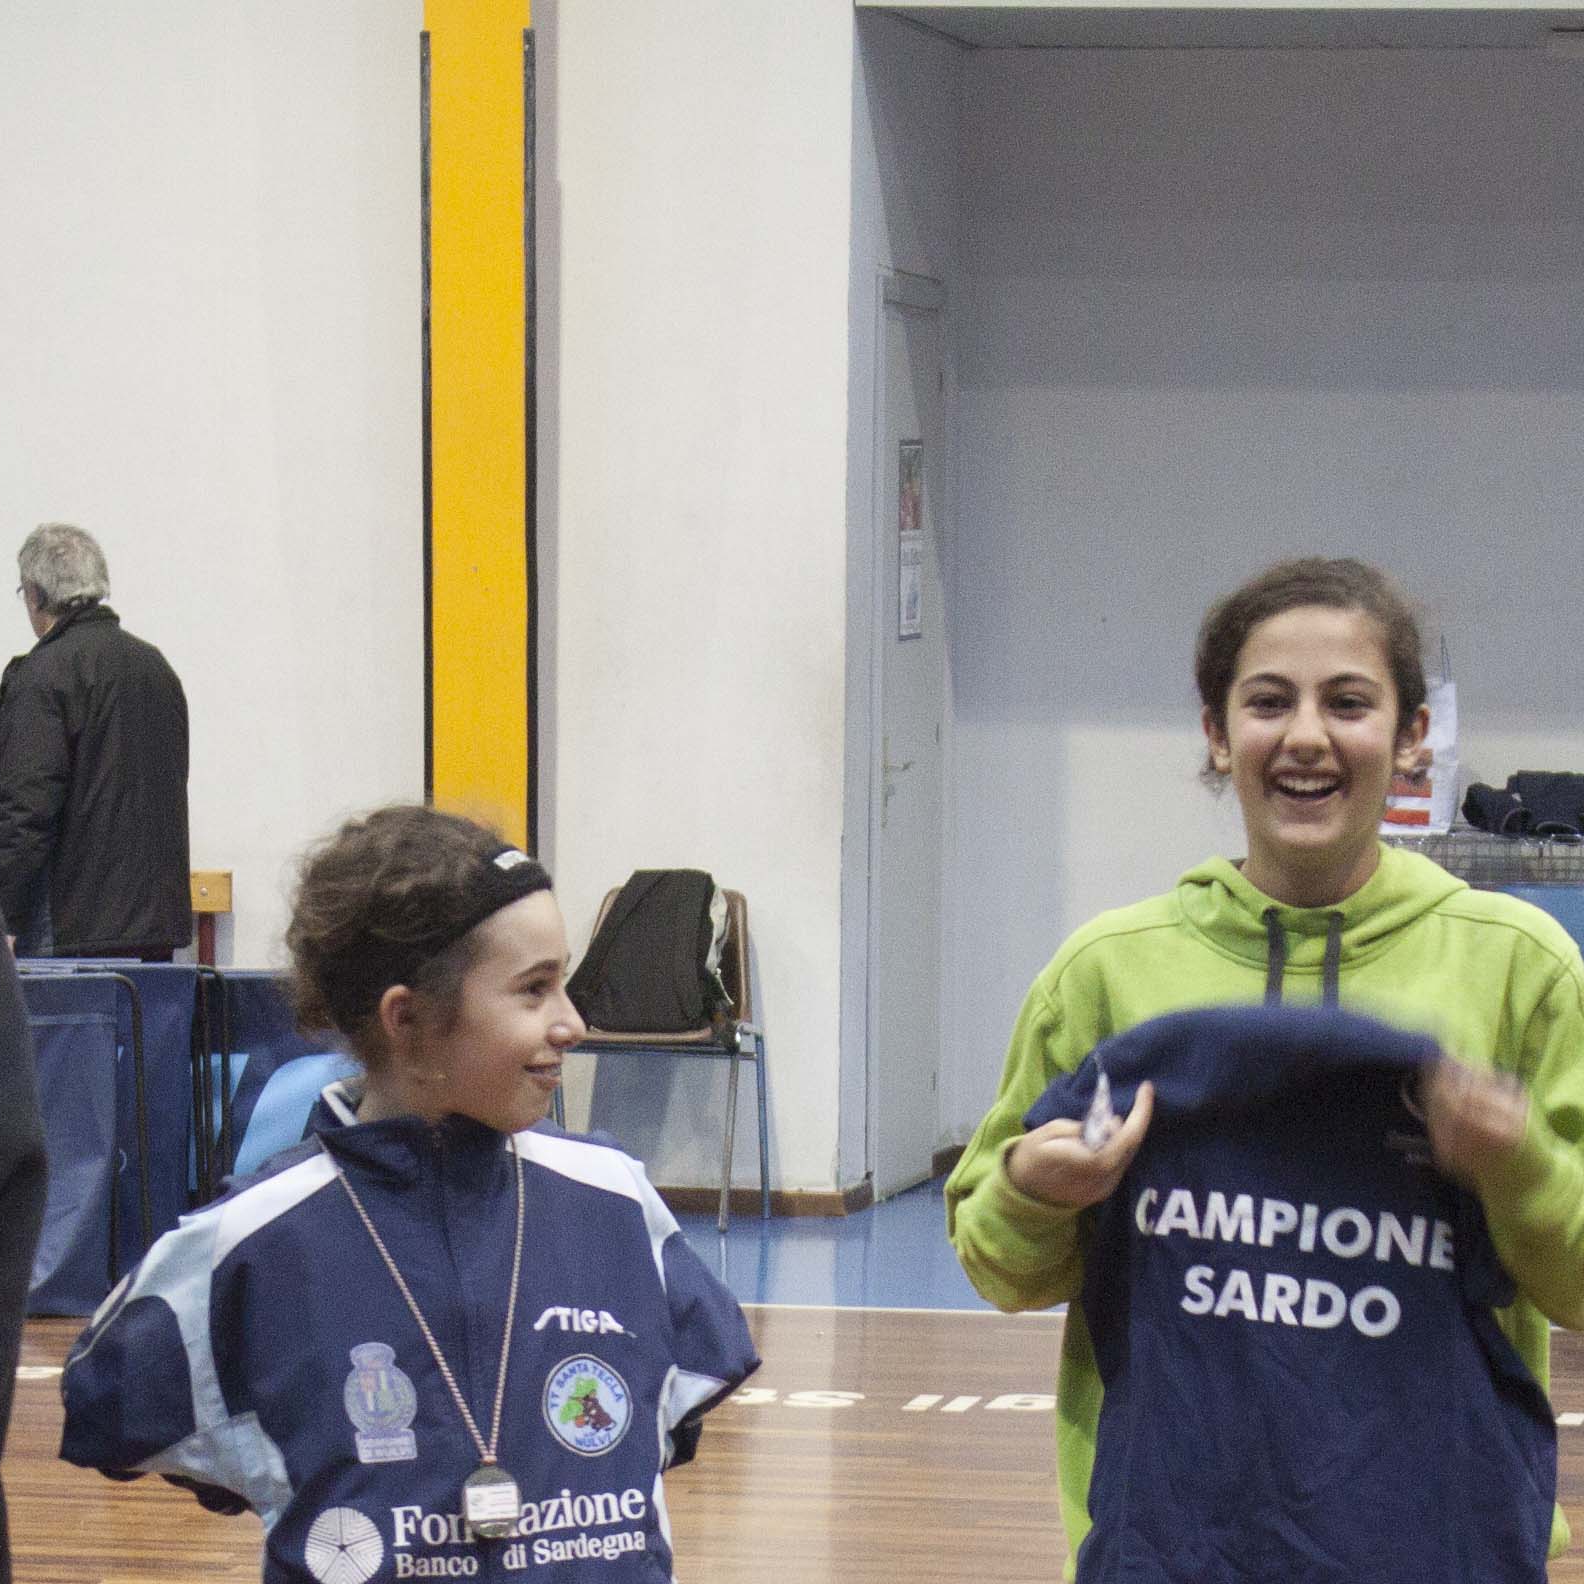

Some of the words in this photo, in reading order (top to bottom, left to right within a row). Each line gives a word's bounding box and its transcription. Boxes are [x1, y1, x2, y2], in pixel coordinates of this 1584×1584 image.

[1134, 1187, 1456, 1272] CAMPIONE
[533, 1305, 625, 1335] STIGA
[1180, 1264, 1403, 1338] SARDO
[556, 1362, 589, 1389] SANTA
[591, 1365, 625, 1403] TECLA
[900, 1392, 1057, 1413] gli
[391, 1487, 646, 1548] Fonazione
[395, 1552, 479, 1579] Banco
[502, 1542, 528, 1570] di
[532, 1530, 646, 1565] Sardegna
